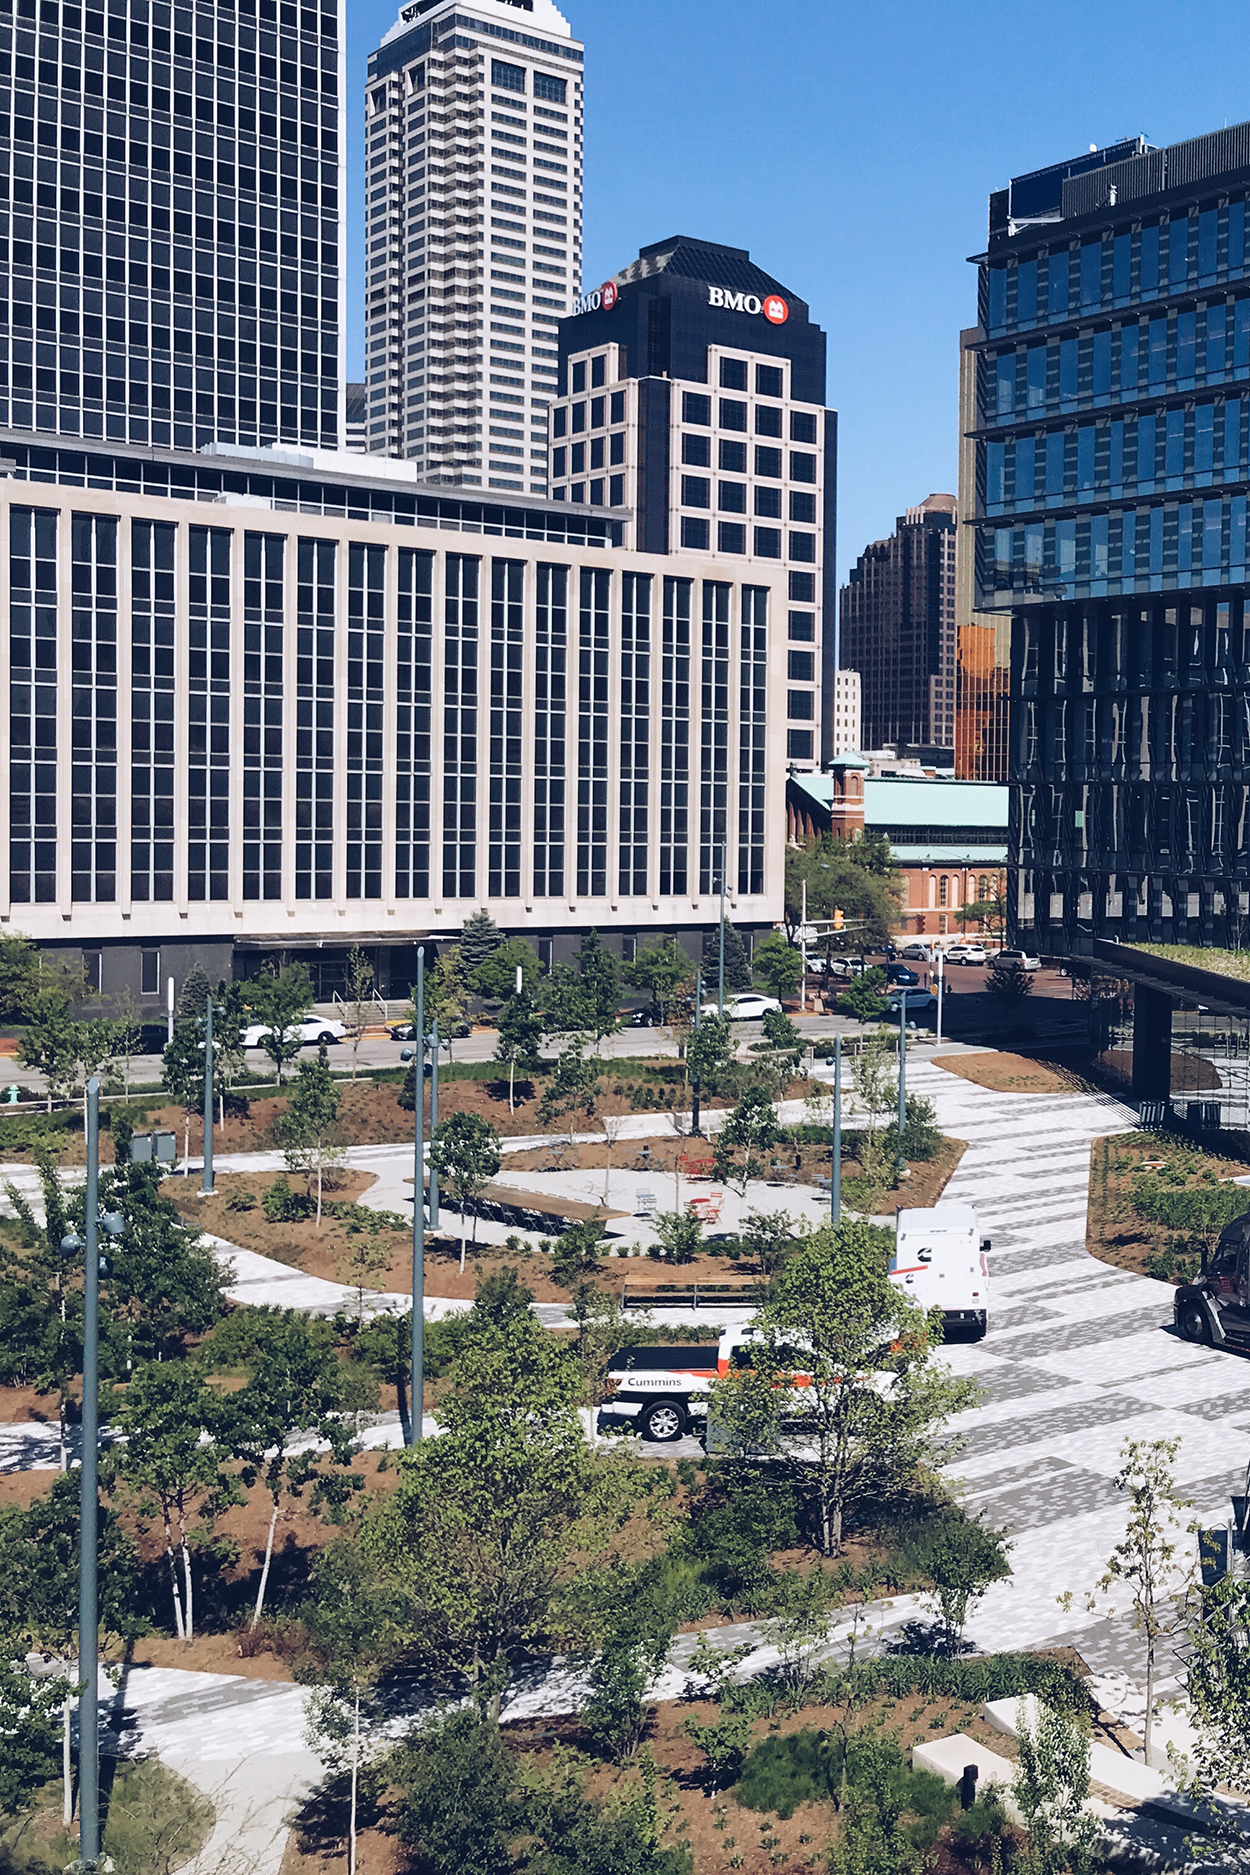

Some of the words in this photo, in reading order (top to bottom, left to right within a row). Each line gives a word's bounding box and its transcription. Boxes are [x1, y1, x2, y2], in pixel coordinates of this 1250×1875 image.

[572, 291, 601, 317] BMO
[707, 285, 762, 315] BMO
[627, 1377, 682, 1387] Cummins
